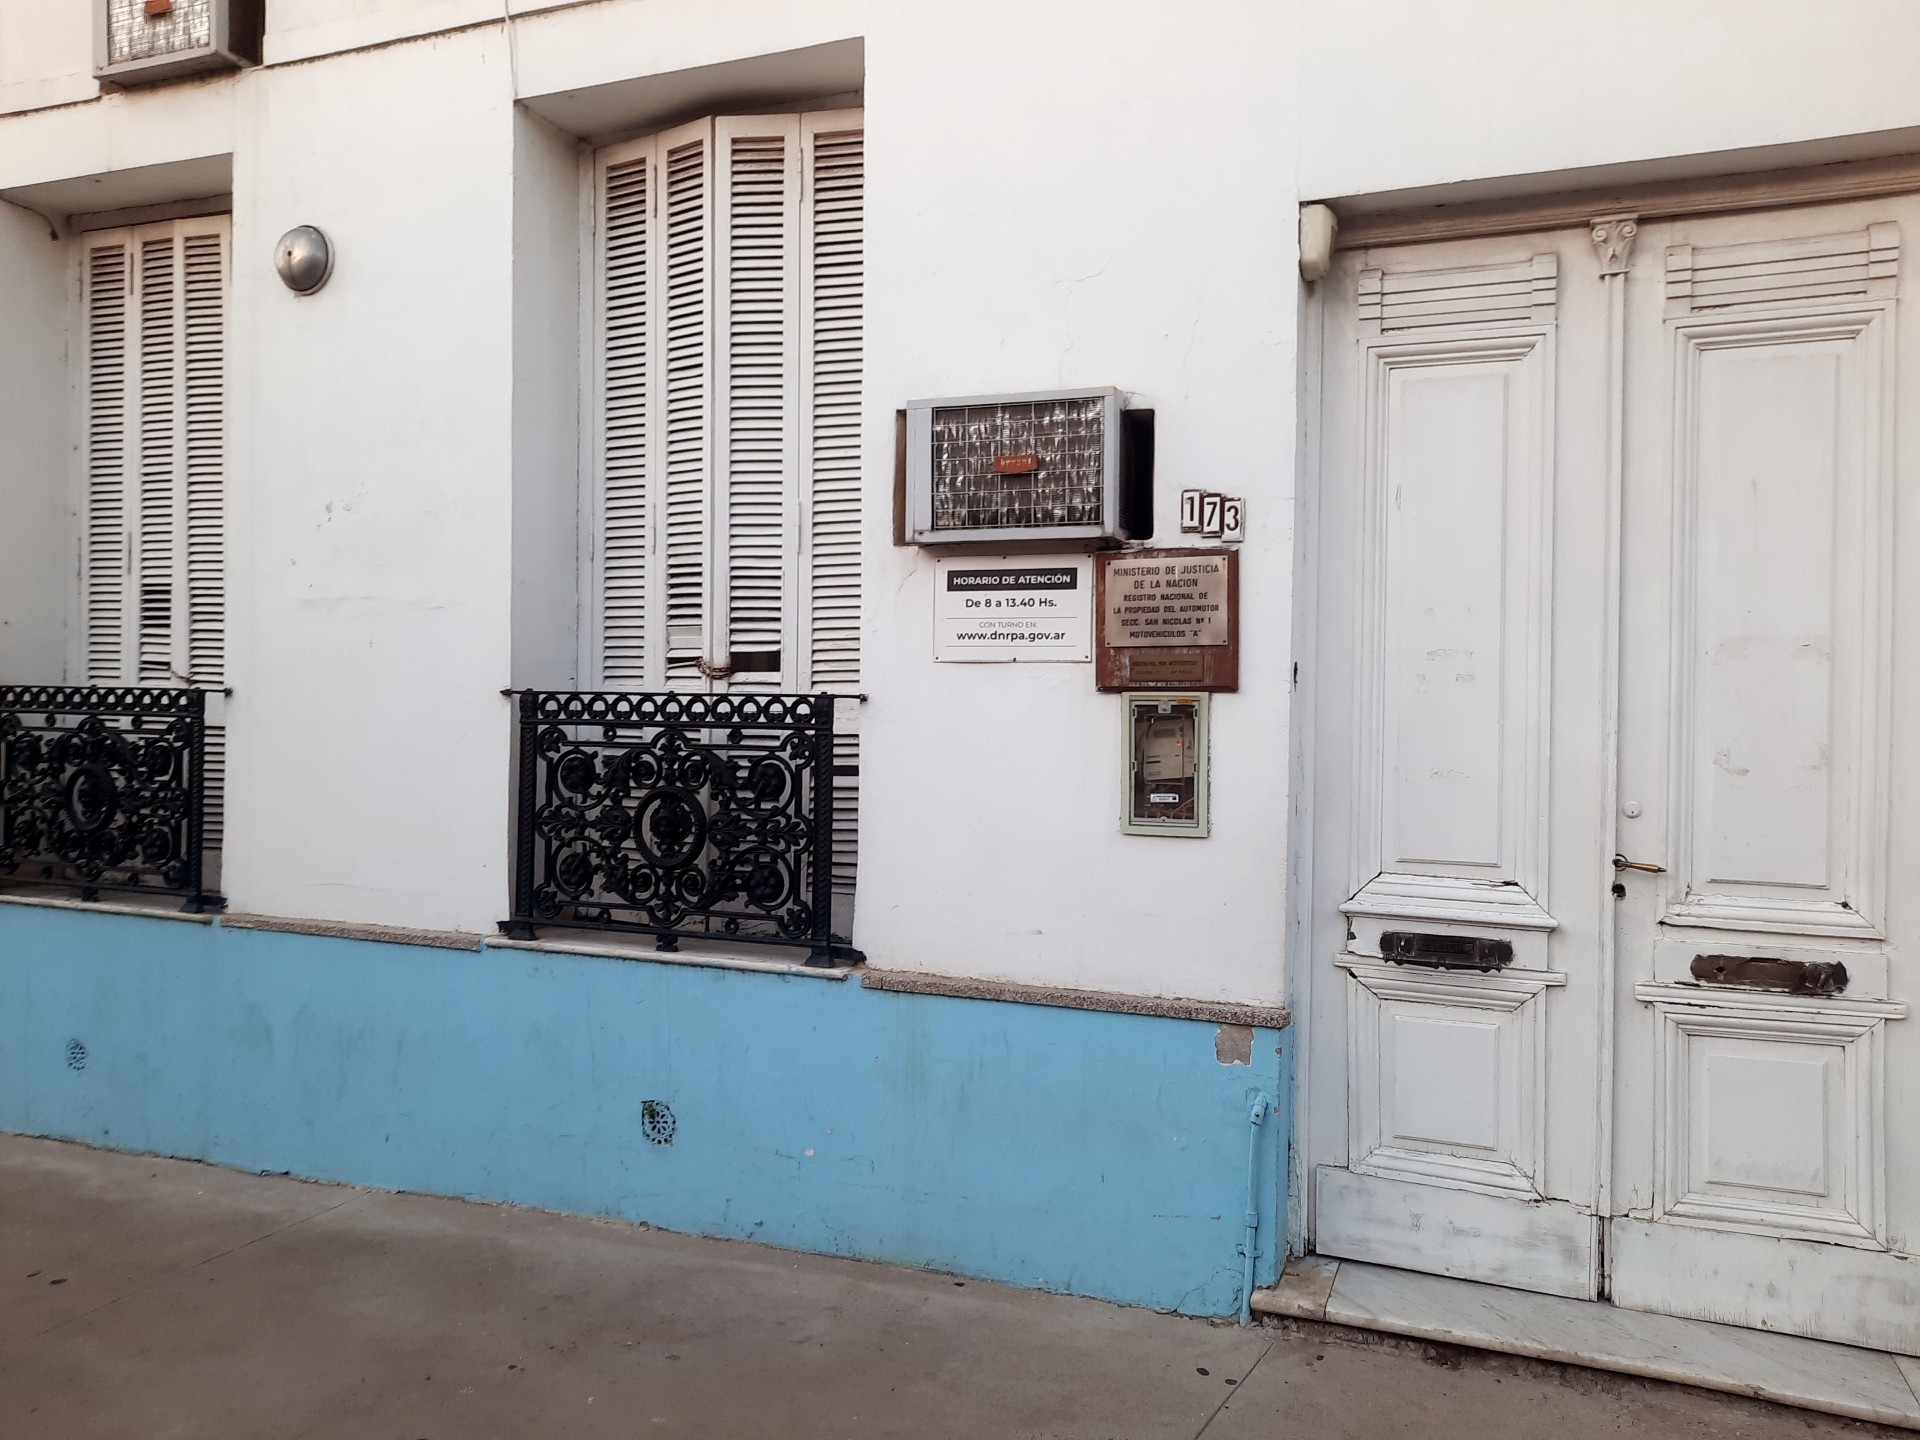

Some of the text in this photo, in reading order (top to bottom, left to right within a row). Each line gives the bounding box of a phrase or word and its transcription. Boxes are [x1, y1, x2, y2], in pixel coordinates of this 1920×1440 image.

[1186, 496, 1239, 531] 173
[1113, 565, 1219, 577] MINISTERIO DE JUSTICIA
[953, 573, 1070, 585] HORARIO DE ATENCIÓN
[1134, 579, 1198, 589] DE LA NACION
[966, 599, 981, 608] De
[985, 599, 992, 607] 8
[1006, 598, 1035, 607] 13.40
[1038, 598, 1057, 607] Hs.
[957, 631, 1065, 642] www.dnrpa.gov.ar
